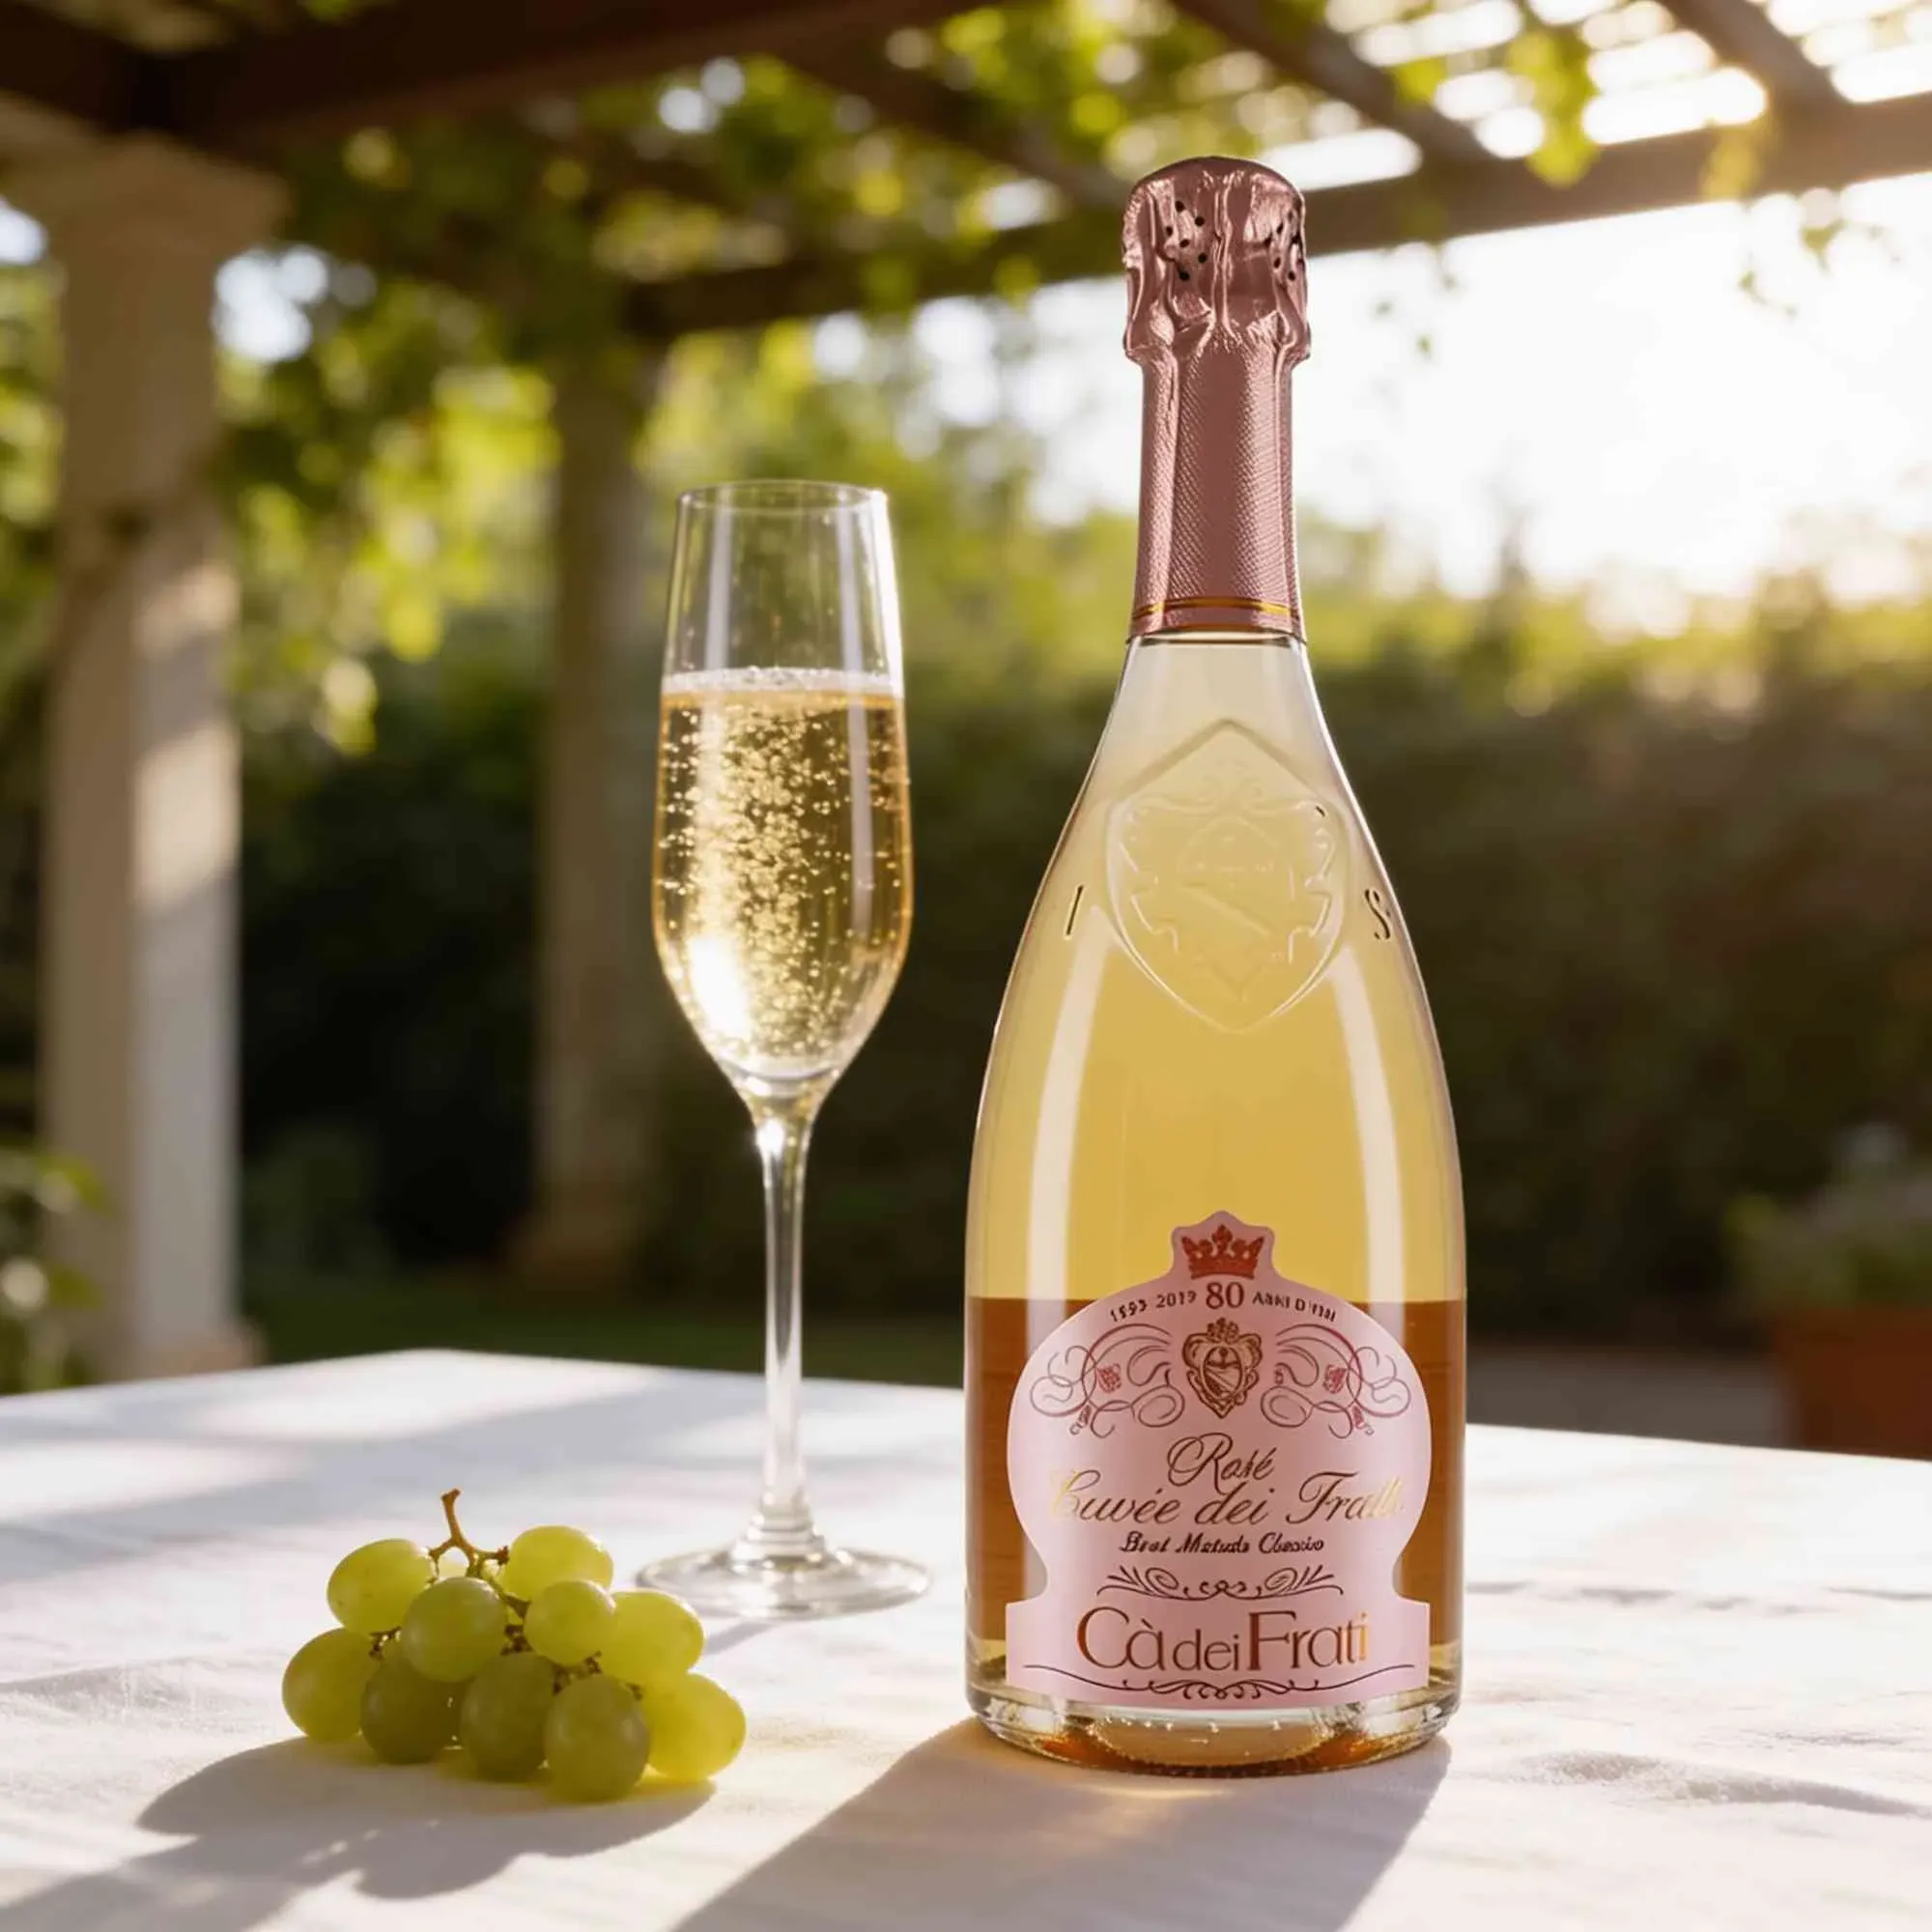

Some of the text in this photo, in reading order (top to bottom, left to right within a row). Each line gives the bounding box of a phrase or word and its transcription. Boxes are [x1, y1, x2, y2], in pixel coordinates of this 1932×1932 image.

[1205, 1281, 1245, 1310] 80
[1193, 1480, 1276, 1525] dei
[1076, 1605, 1371, 1672] Cà dei Frati
